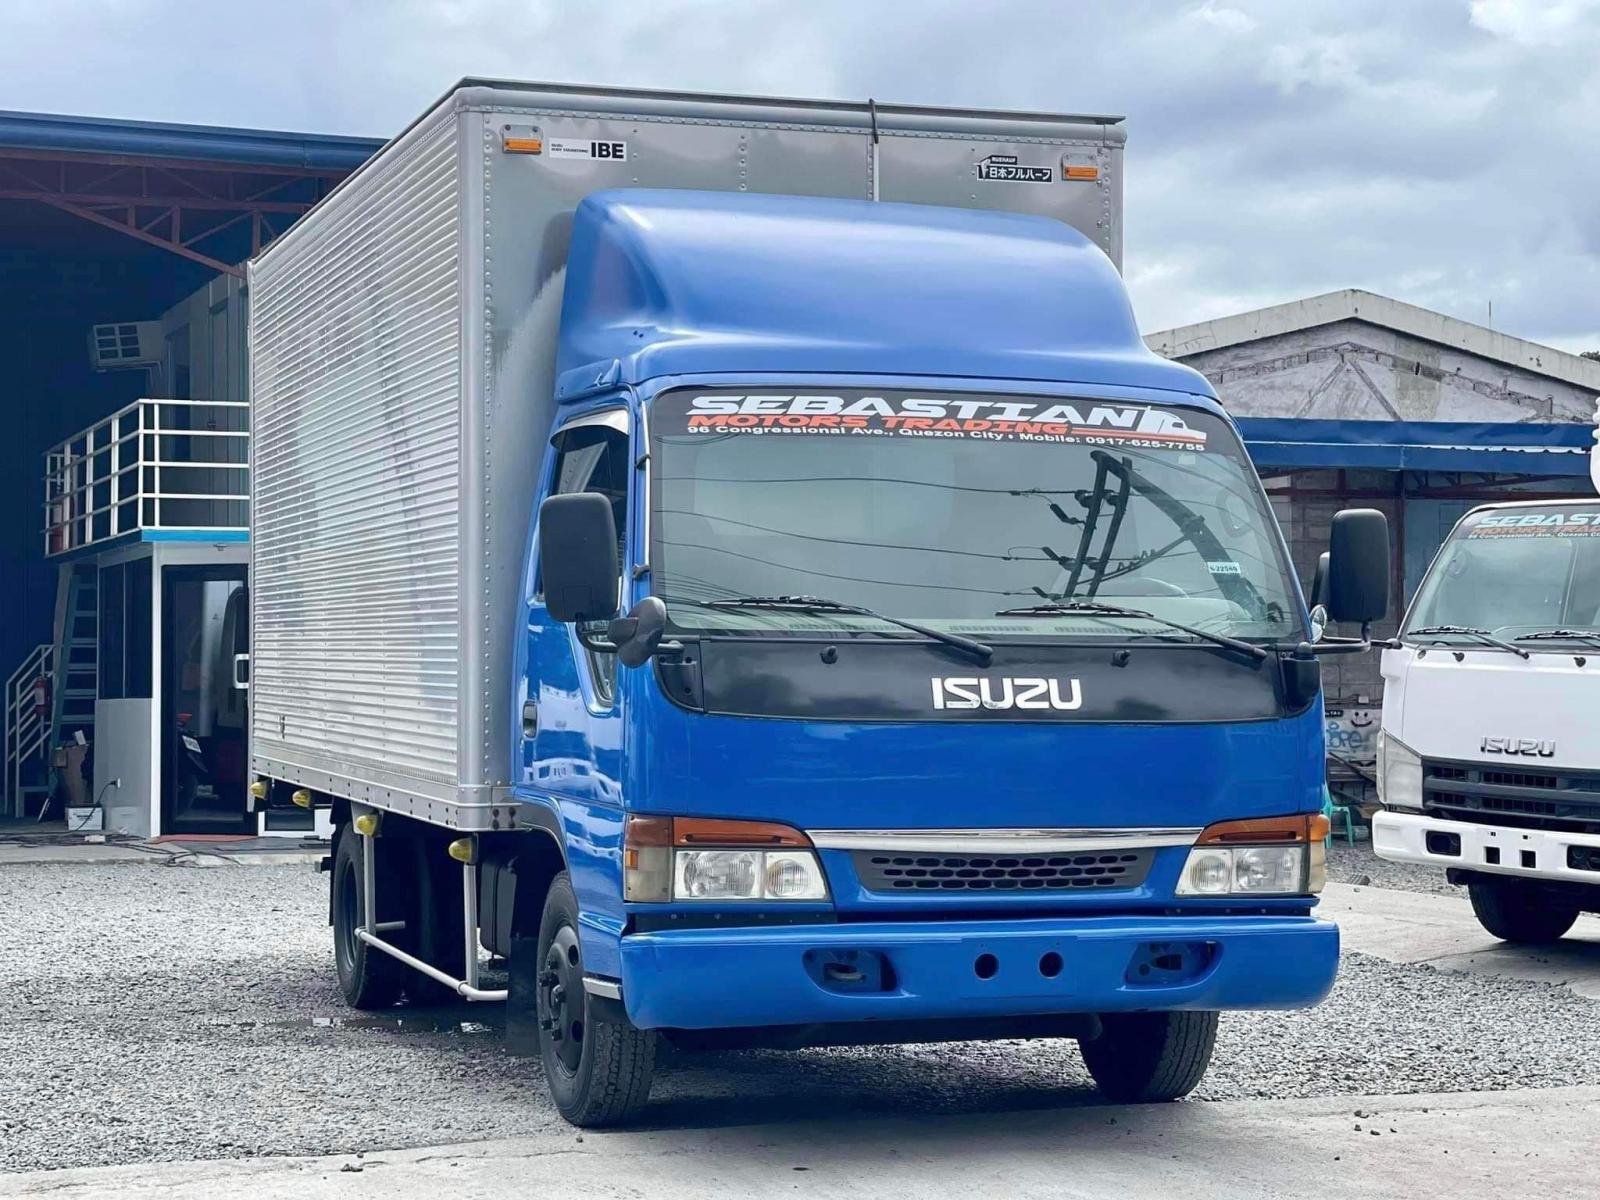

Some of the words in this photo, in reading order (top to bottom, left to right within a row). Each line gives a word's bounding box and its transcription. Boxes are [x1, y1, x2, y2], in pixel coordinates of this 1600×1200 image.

[591, 142, 624, 159] IBE
[989, 167, 1051, 180] 日本フルハーフ
[686, 395, 1140, 428] SEBASTIAN
[687, 414, 870, 429] MOTORS
[884, 416, 1068, 434] TRADING
[687, 426, 711, 434] 96
[715, 426, 846, 436] Congressional
[899, 428, 965, 438] Quezon
[970, 430, 1003, 441] City
[1019, 433, 1081, 443] Mobile:
[1086, 436, 1205, 451] 0917-625-7755
[931, 677, 1082, 710] ISUZU
[1480, 735, 1556, 758] ISUZU
